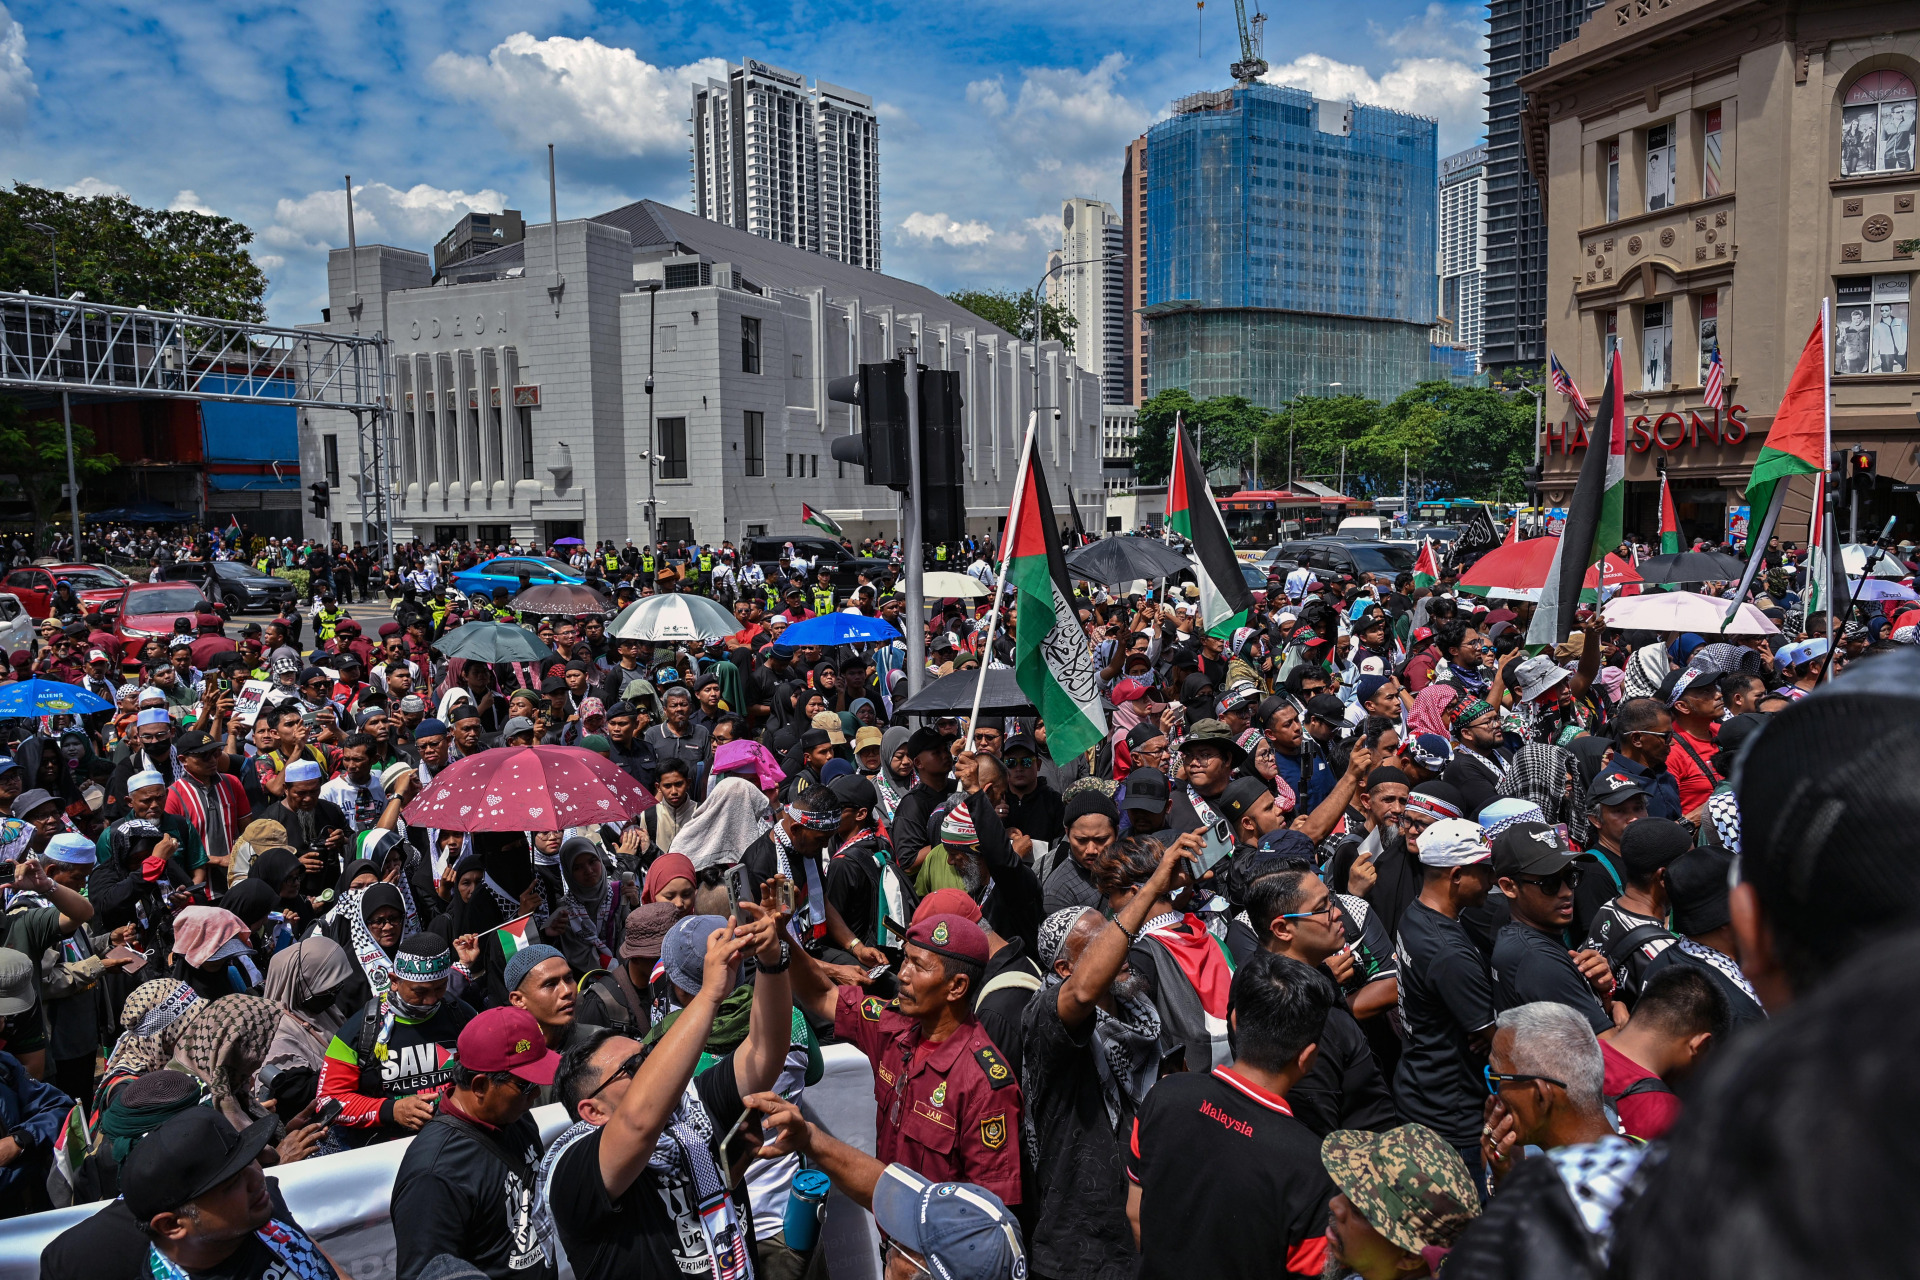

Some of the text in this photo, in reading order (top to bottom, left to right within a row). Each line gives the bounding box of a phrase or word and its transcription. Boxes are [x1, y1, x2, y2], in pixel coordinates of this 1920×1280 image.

[1838, 286, 1862, 294] KILLER
[410, 310, 508, 341] ODEON
[1545, 404, 1750, 457] HASONS
[1199, 1100, 1254, 1138] Malaysia
[930, 1253, 955, 1280] PETRONA
